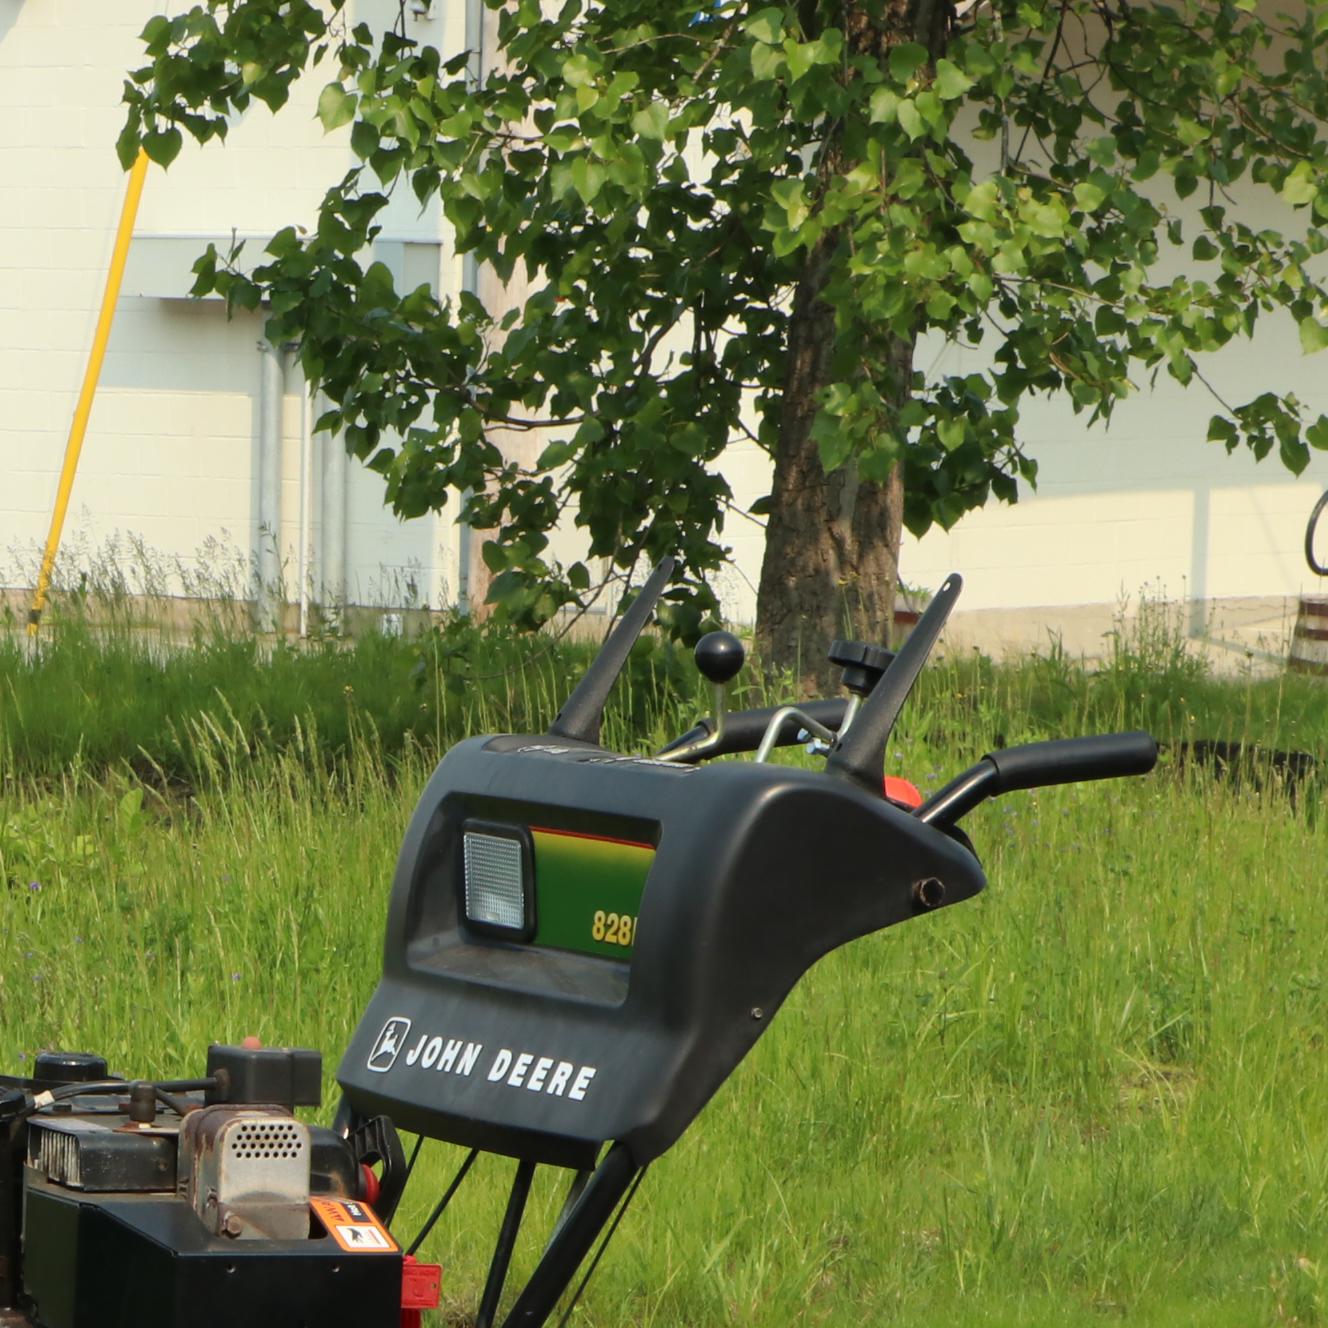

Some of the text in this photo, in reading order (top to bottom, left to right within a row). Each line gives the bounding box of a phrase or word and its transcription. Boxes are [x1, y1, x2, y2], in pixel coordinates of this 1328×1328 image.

[592, 910, 632, 946] 828
[406, 1034, 596, 1101] JOHN DEERE
